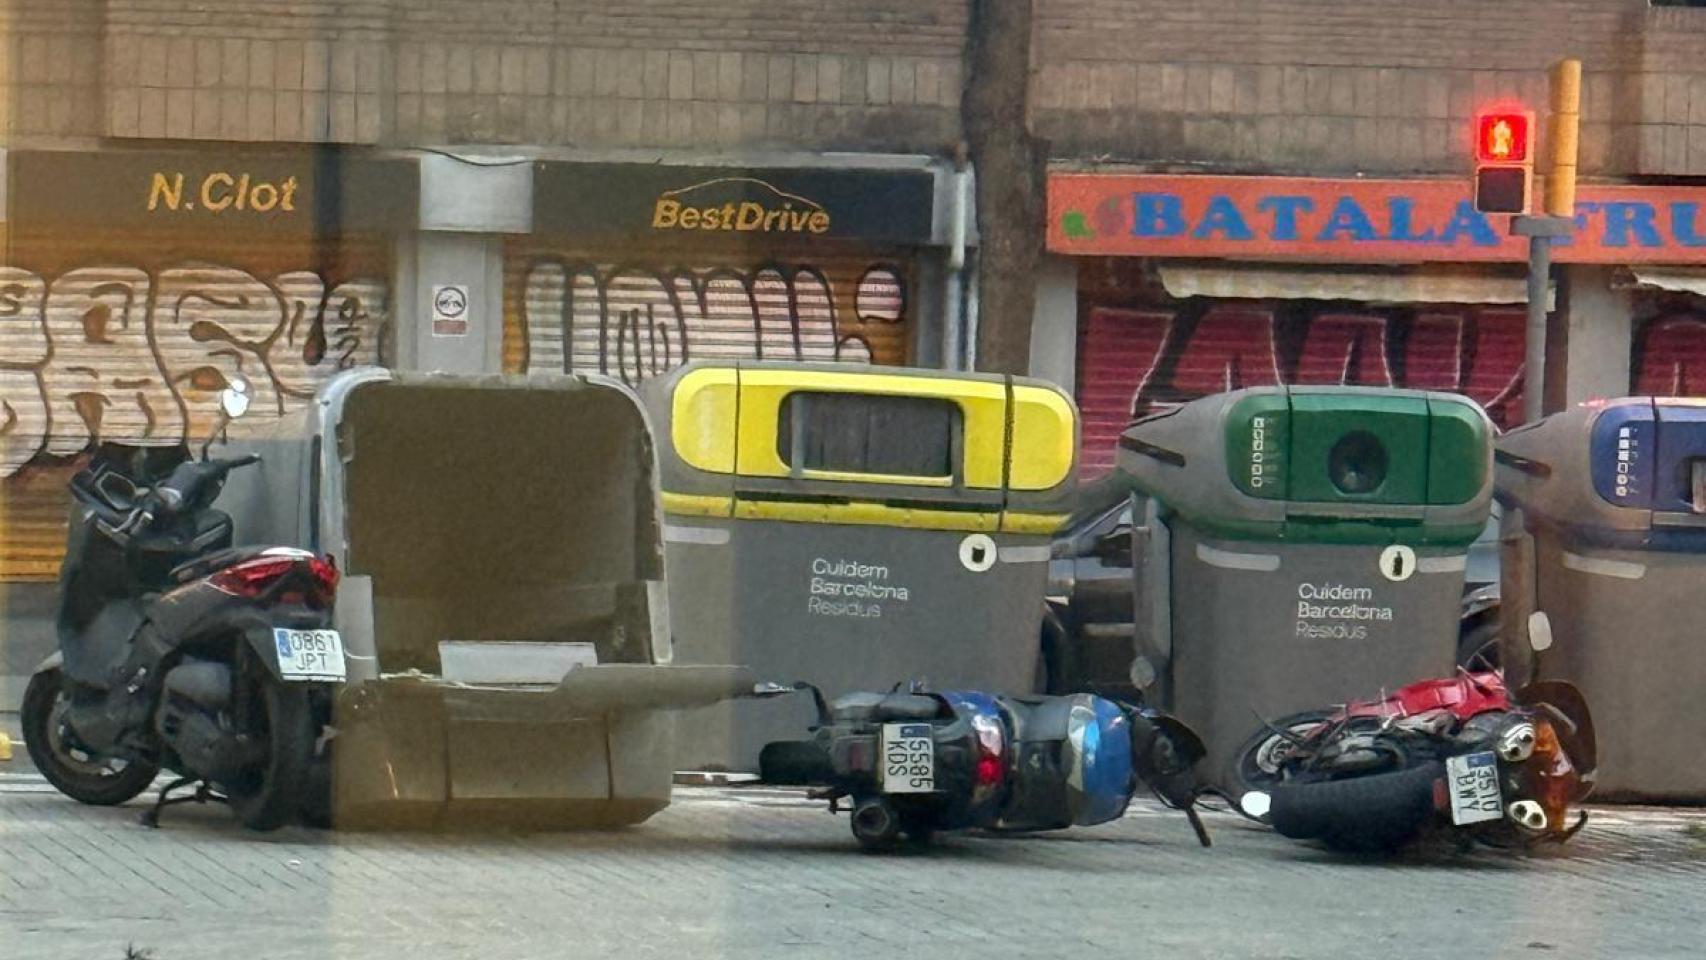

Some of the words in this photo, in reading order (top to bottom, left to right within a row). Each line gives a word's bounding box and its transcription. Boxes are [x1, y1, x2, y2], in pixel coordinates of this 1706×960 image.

[651, 199, 831, 234] BestDrive
[1130, 192, 1500, 246] BATALA
[812, 557, 888, 579] Cuidem
[810, 577, 908, 600] Barcelona
[1298, 582, 1372, 601] Cuidem
[808, 597, 881, 617] Residus
[1297, 601, 1393, 621] Barcelona
[1295, 620, 1368, 639] Residus
[290, 632, 336, 652] 0861
[296, 652, 328, 672] JPT
[887, 740, 908, 776] KDS
[909, 740, 933, 788] 5585
